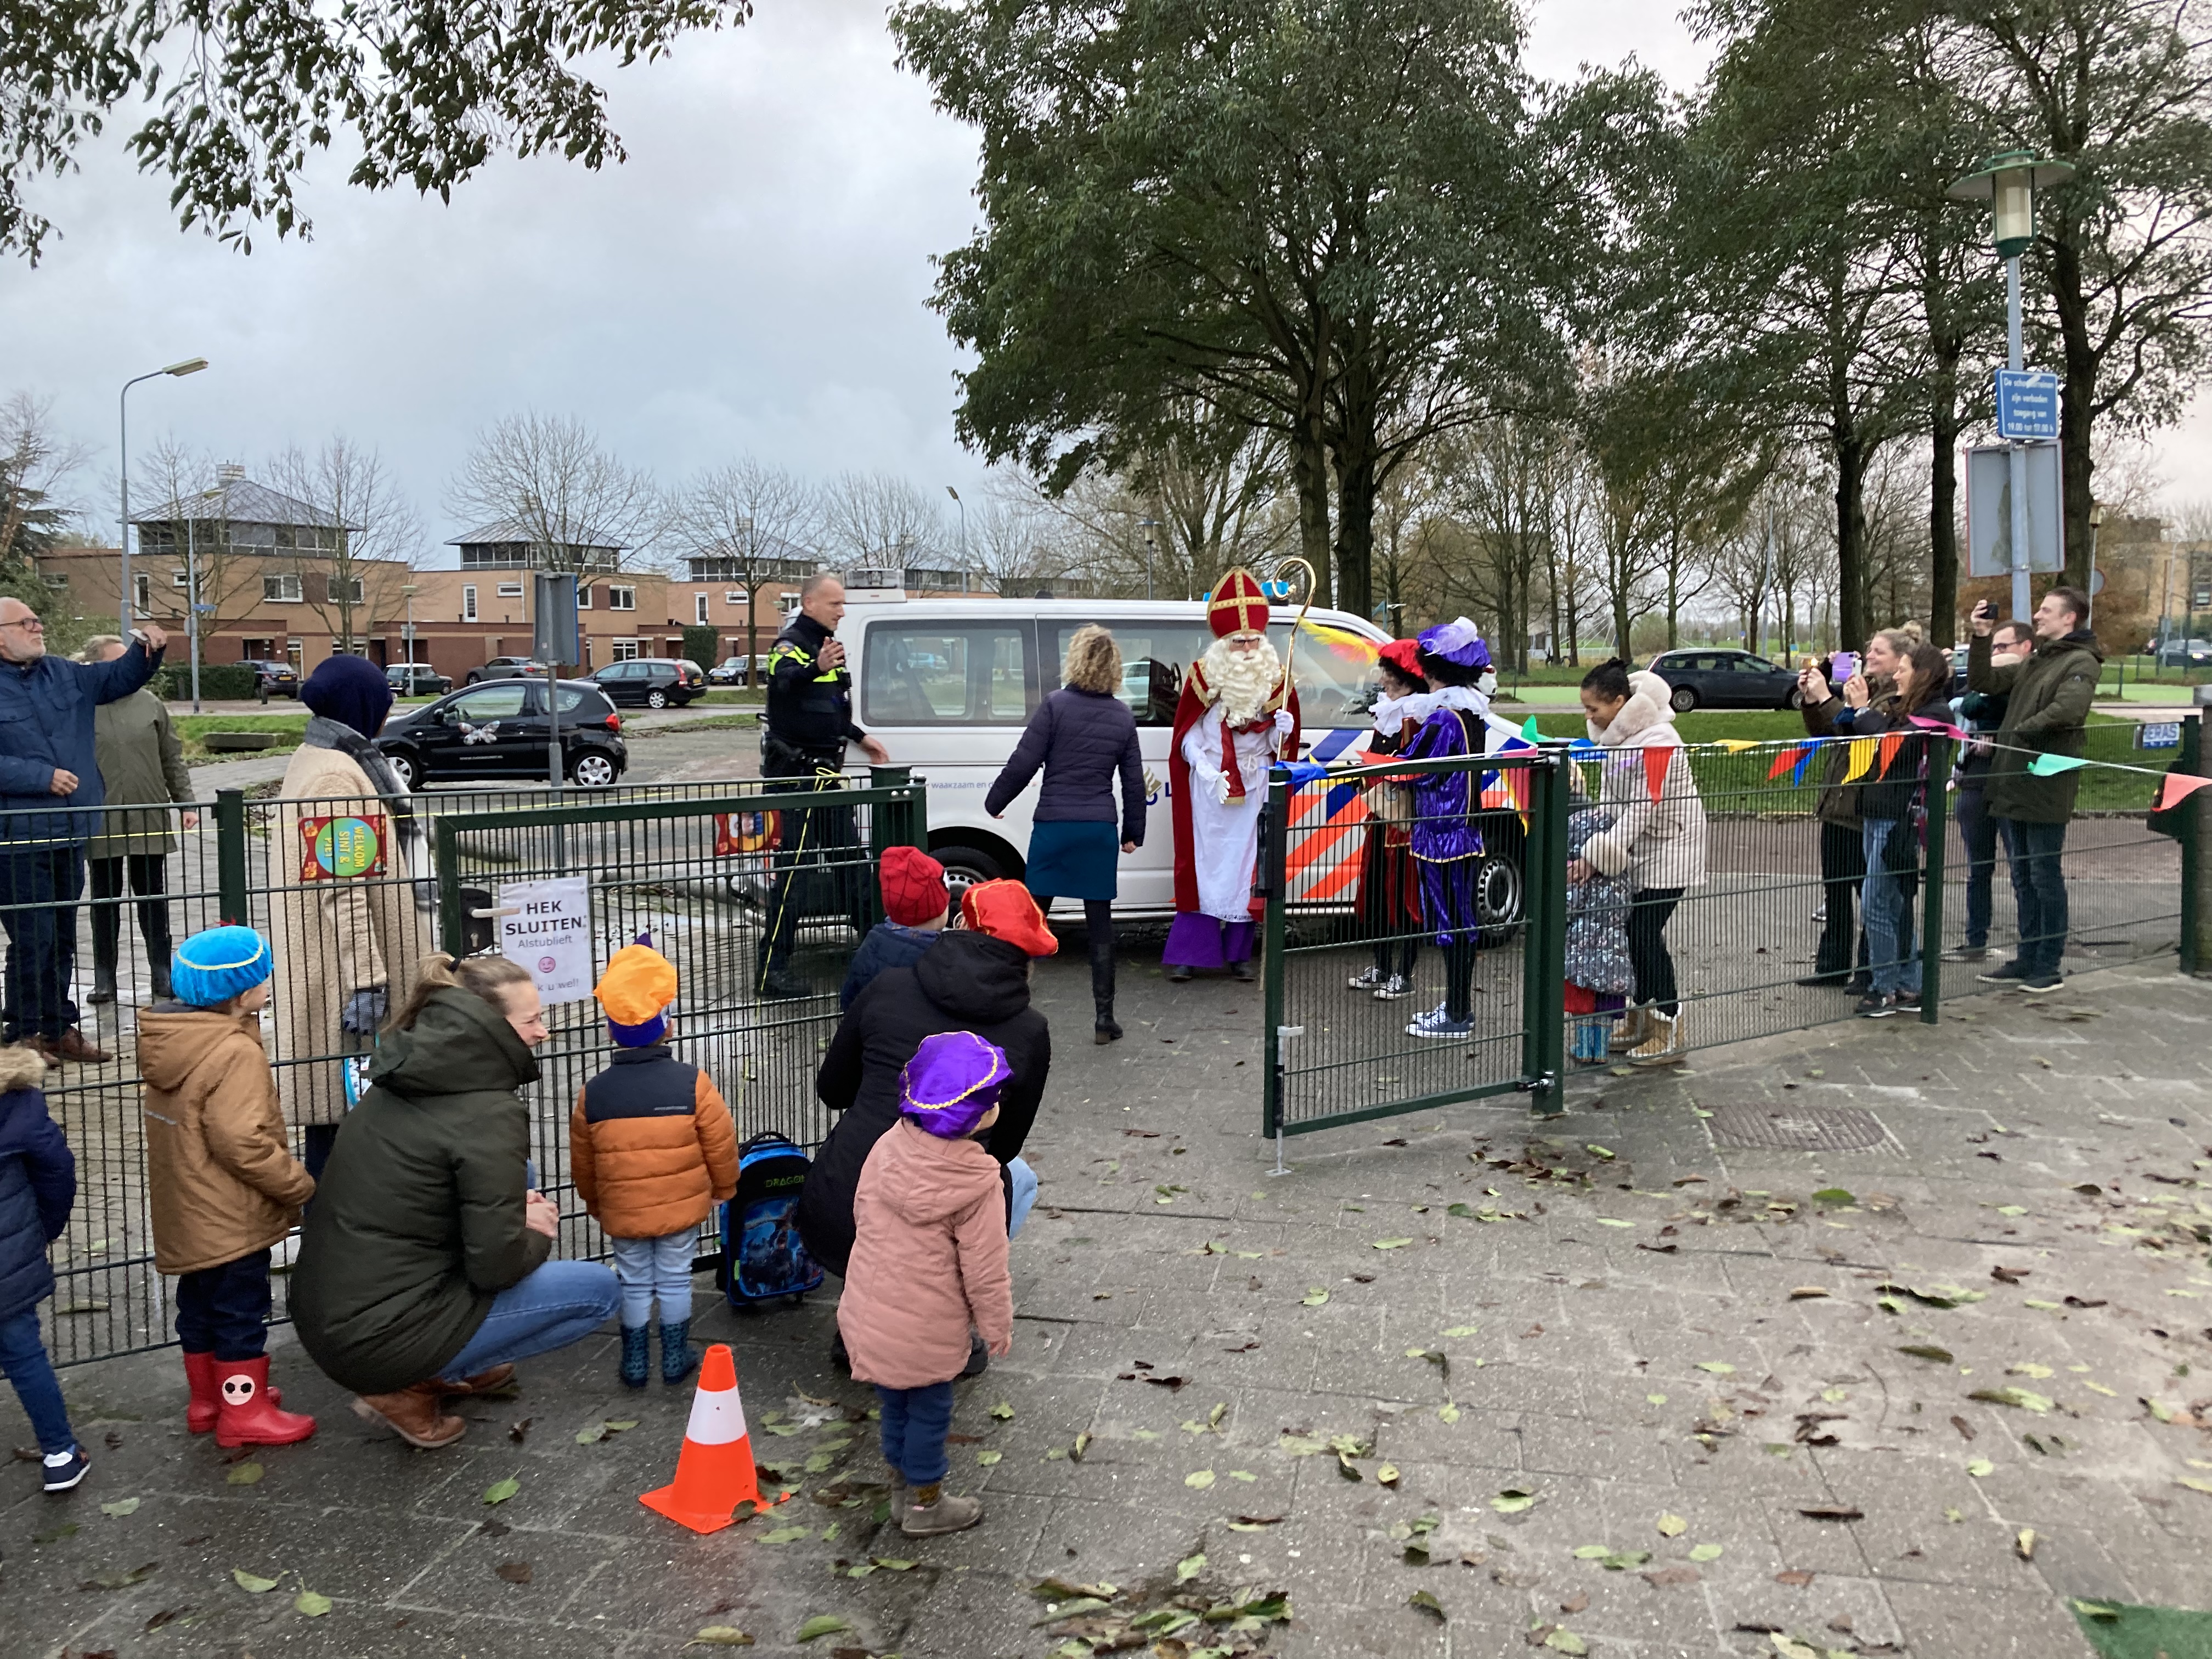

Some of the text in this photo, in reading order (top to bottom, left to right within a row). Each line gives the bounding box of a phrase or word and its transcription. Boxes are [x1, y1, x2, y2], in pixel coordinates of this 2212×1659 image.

[2004, 377, 2012, 386] De
[338, 831, 350, 853] SINT
[354, 826, 365, 867] WELKOM
[527, 900, 562, 915] HEK
[518, 934, 573, 948] Alstublieft
